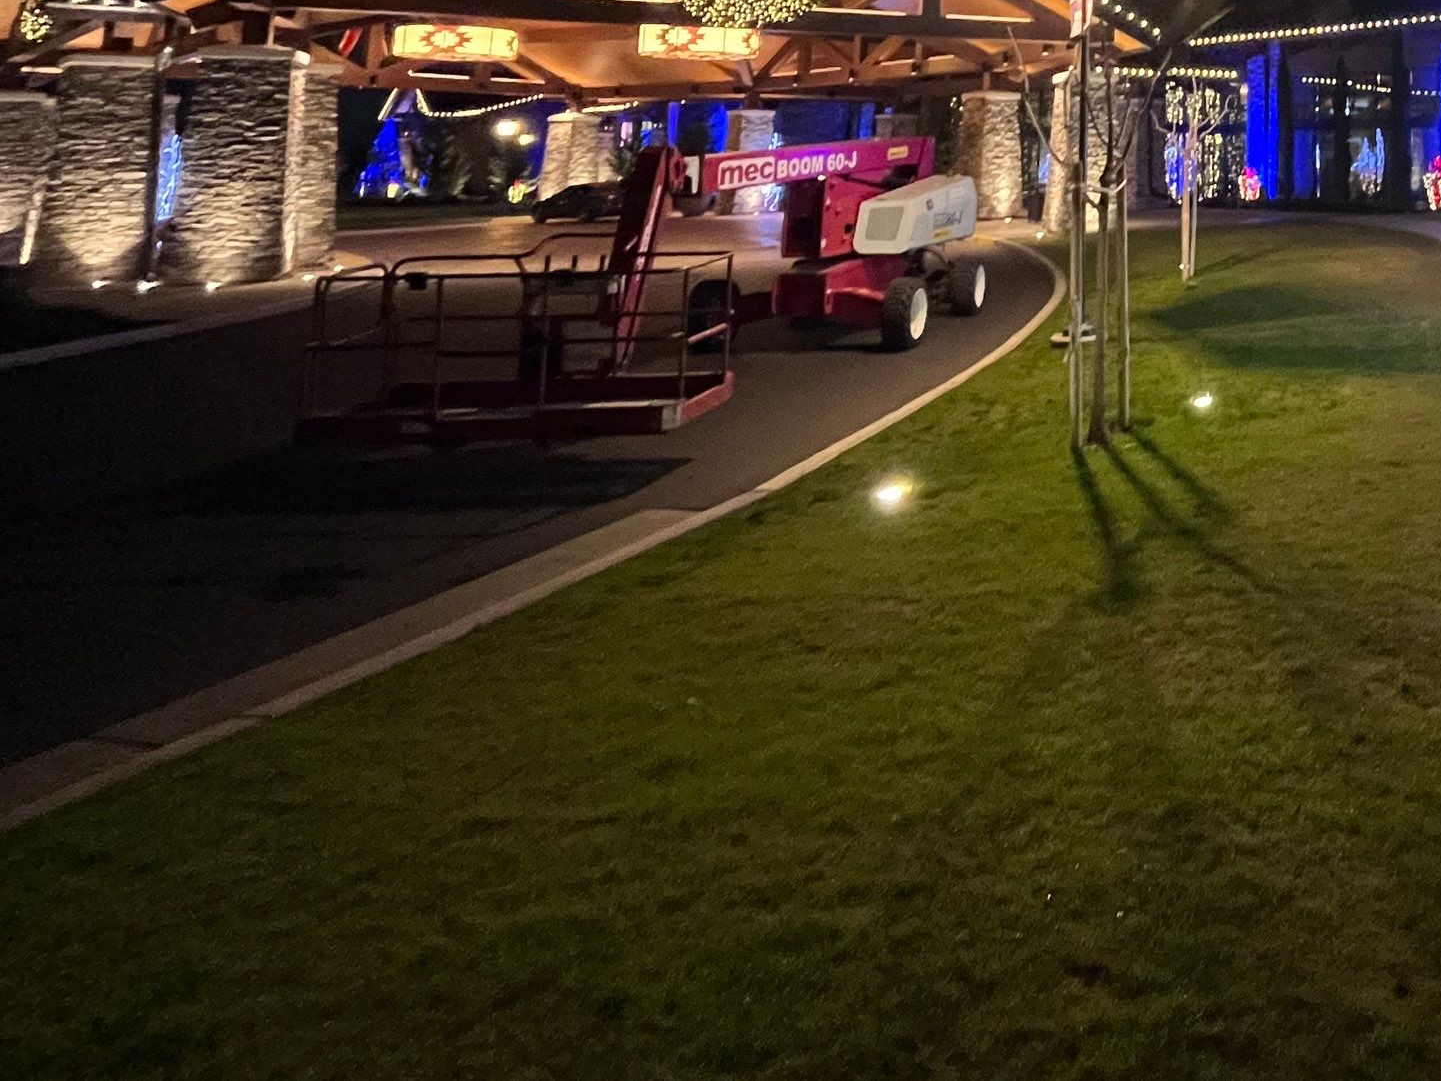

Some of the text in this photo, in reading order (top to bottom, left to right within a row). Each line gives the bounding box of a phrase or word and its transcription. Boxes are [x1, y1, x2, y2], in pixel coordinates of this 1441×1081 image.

[719, 151, 858, 186] mec BOOM 60-J
